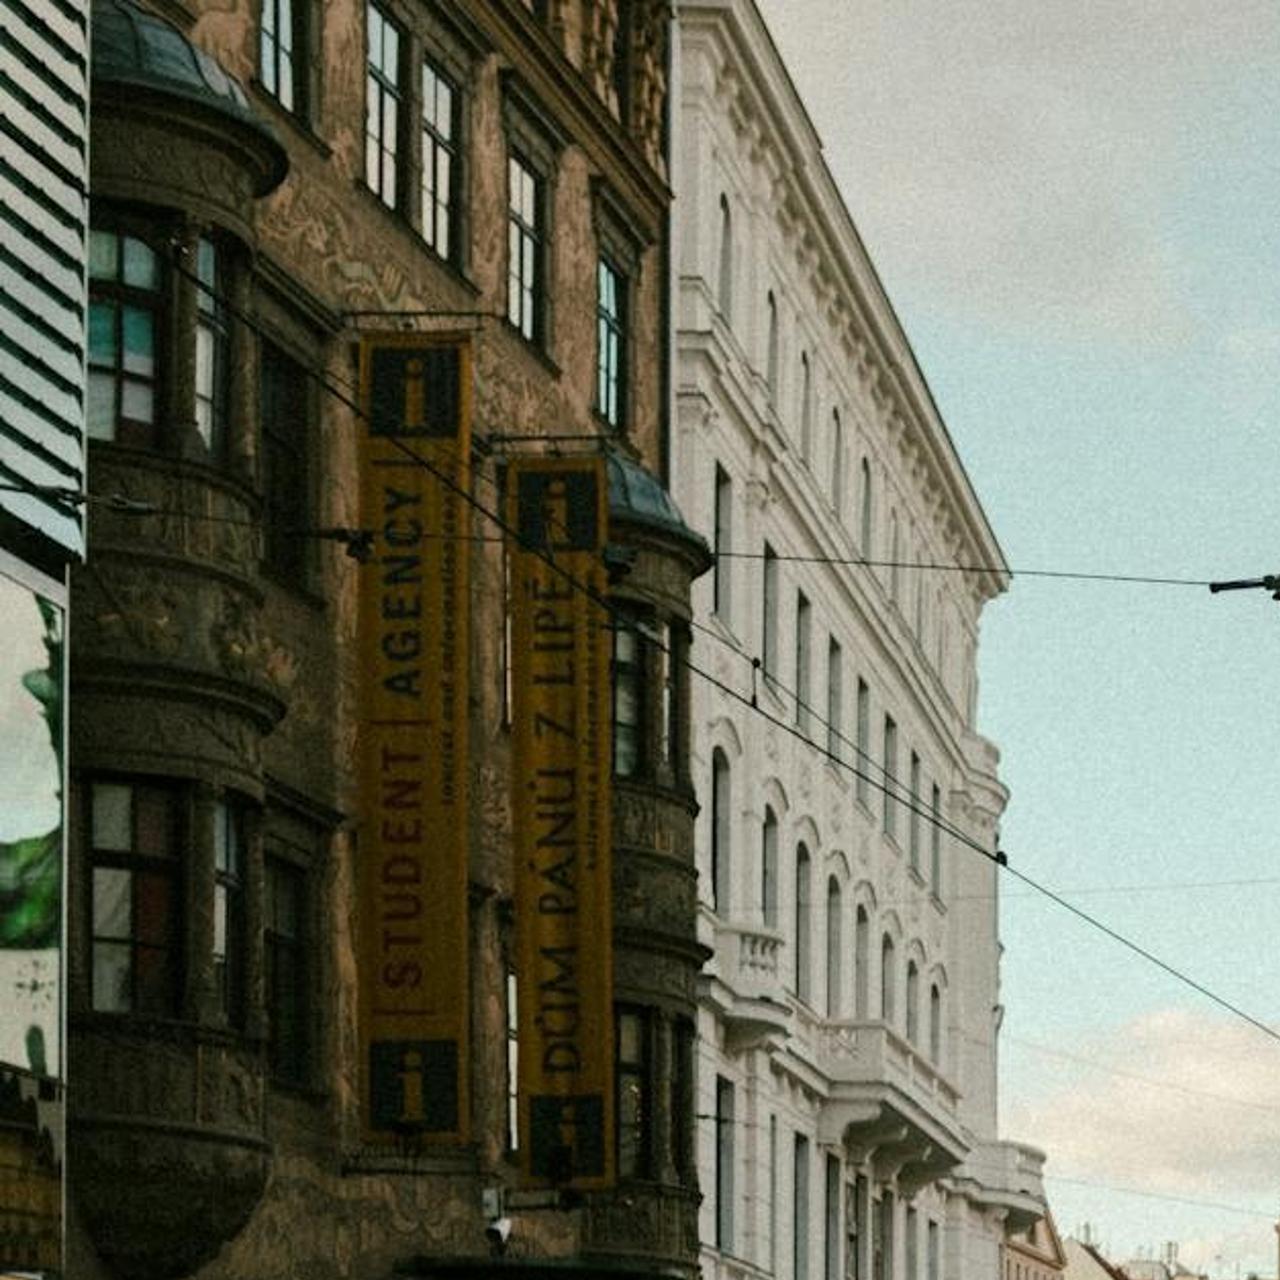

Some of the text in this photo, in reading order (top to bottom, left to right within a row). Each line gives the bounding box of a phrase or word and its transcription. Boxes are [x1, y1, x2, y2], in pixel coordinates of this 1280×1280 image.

[526, 577, 579, 688] LIPÉ
[382, 486, 423, 988] STUDENT AGENCY
[534, 713, 579, 740] Z
